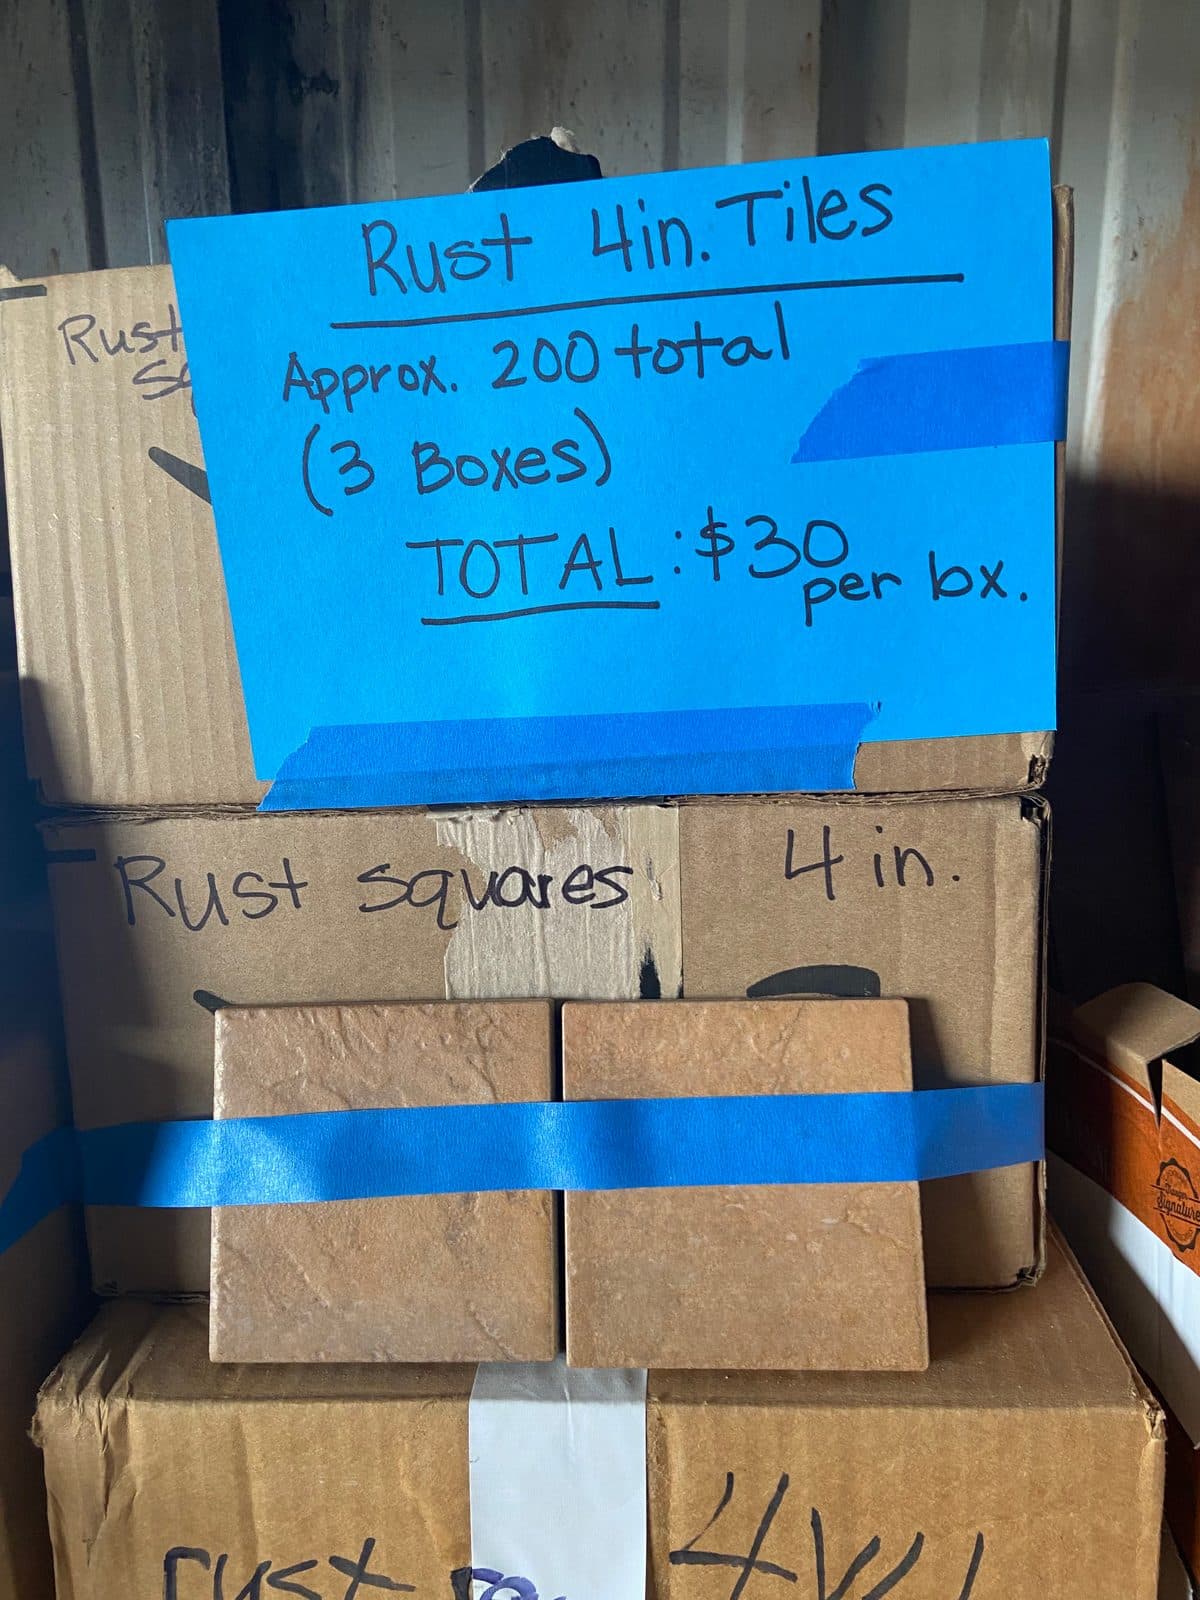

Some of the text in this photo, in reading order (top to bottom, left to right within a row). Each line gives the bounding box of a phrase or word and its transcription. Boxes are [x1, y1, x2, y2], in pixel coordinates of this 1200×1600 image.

[361, 212, 533, 297] Rust
[716, 176, 894, 247] Tiles
[58, 304, 182, 365] Rust
[283, 302, 791, 412] Approx. 200 total
[302, 407, 613, 516] (3 Boxes)
[695, 505, 849, 581] $30
[804, 550, 1030, 628] per bx.
[117, 853, 309, 932] Rust
[785, 825, 965, 903] 4 in.
